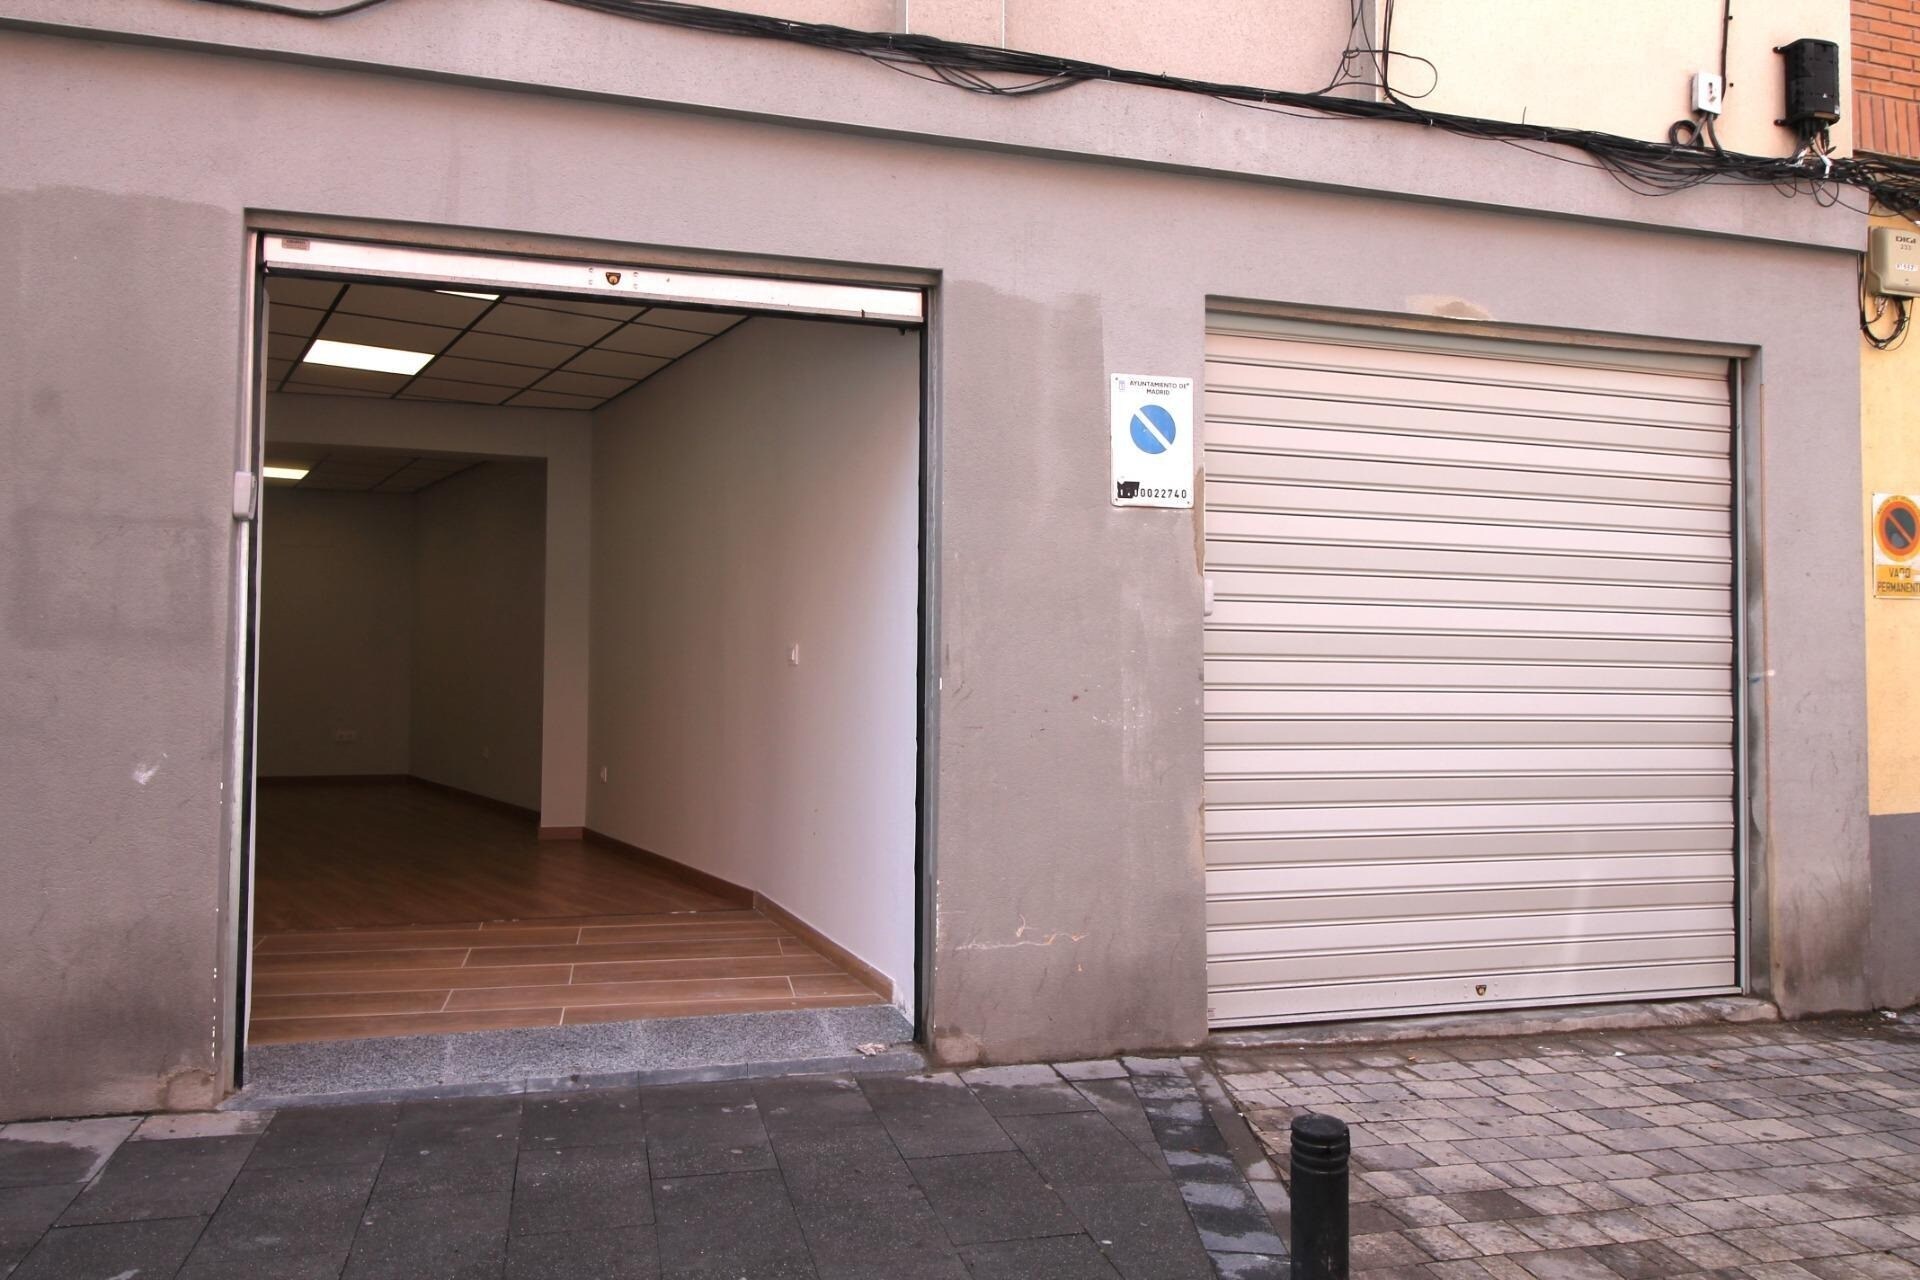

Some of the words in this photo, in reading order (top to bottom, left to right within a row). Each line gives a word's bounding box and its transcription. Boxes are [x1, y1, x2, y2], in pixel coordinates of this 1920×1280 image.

[1895, 236, 1917, 244] DIGI
[1130, 380, 1178, 389] AYUNTAMIENTO
[1146, 388, 1170, 396] MADRID
